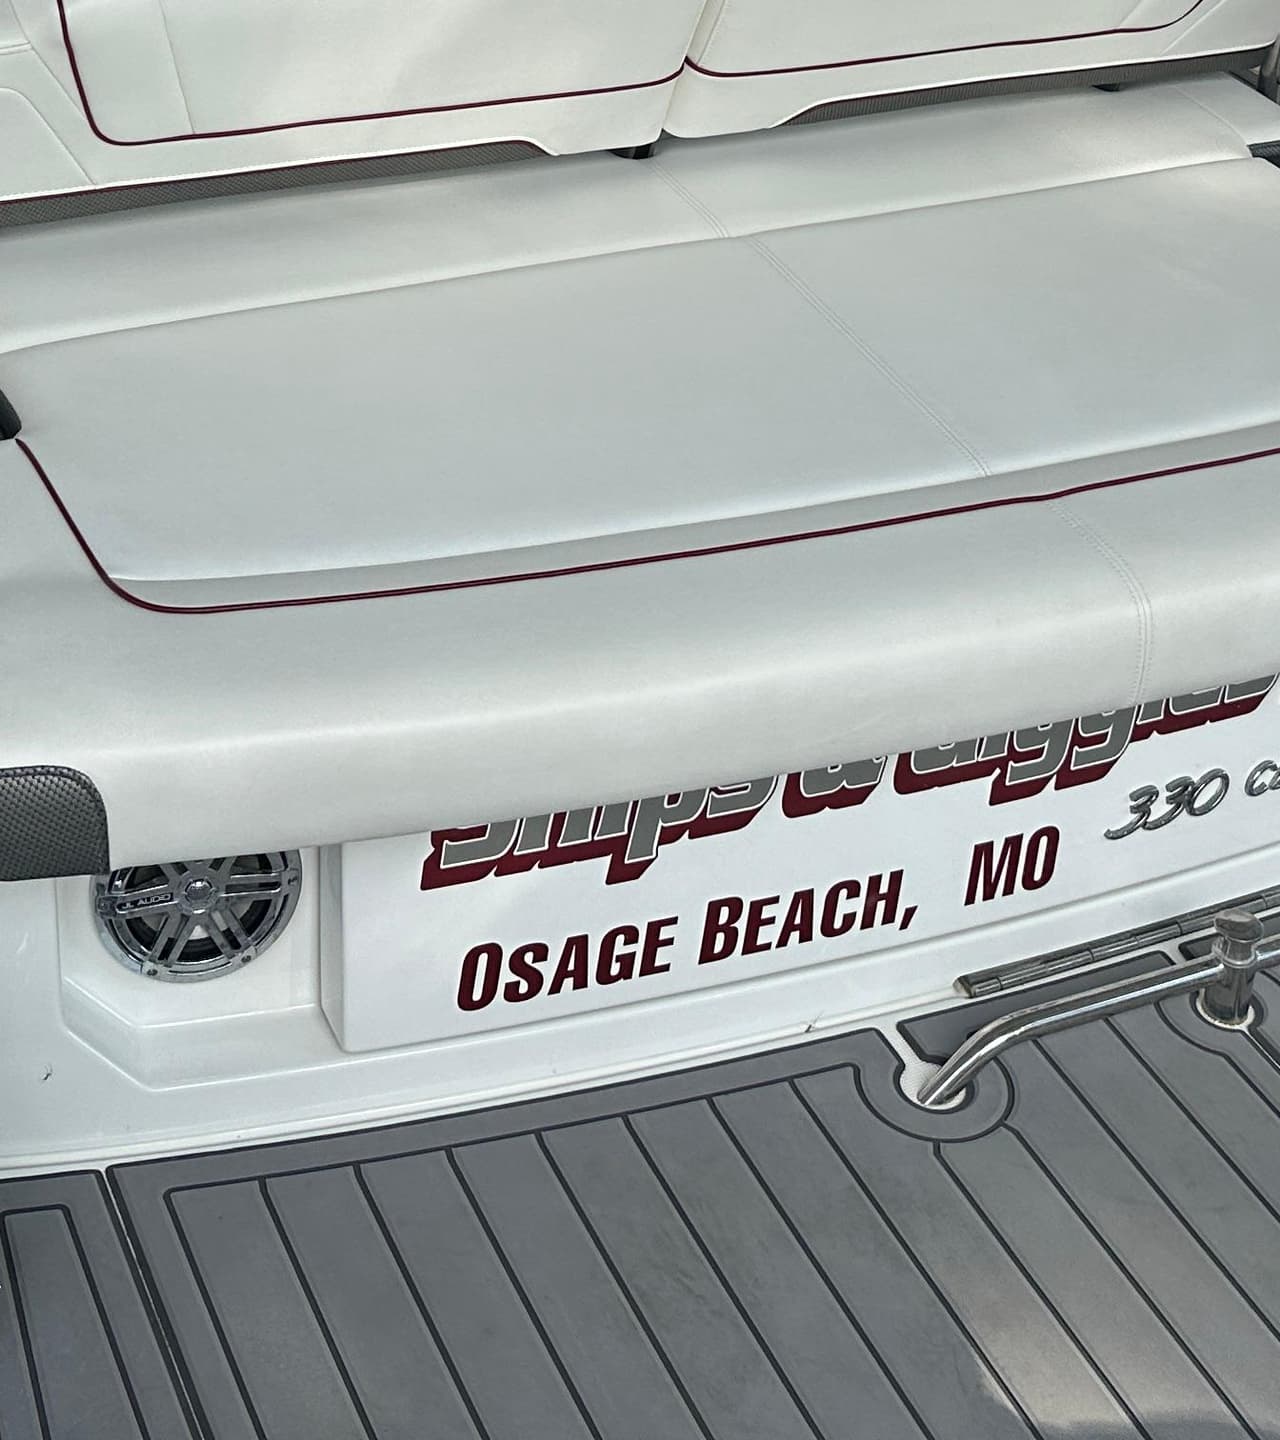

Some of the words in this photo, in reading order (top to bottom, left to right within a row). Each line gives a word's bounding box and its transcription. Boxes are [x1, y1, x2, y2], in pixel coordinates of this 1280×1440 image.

[1104, 767, 1230, 841] 330
[456, 915, 679, 1012] OSAGE
[698, 868, 919, 965] BEACH,
[964, 824, 1061, 906] MO
